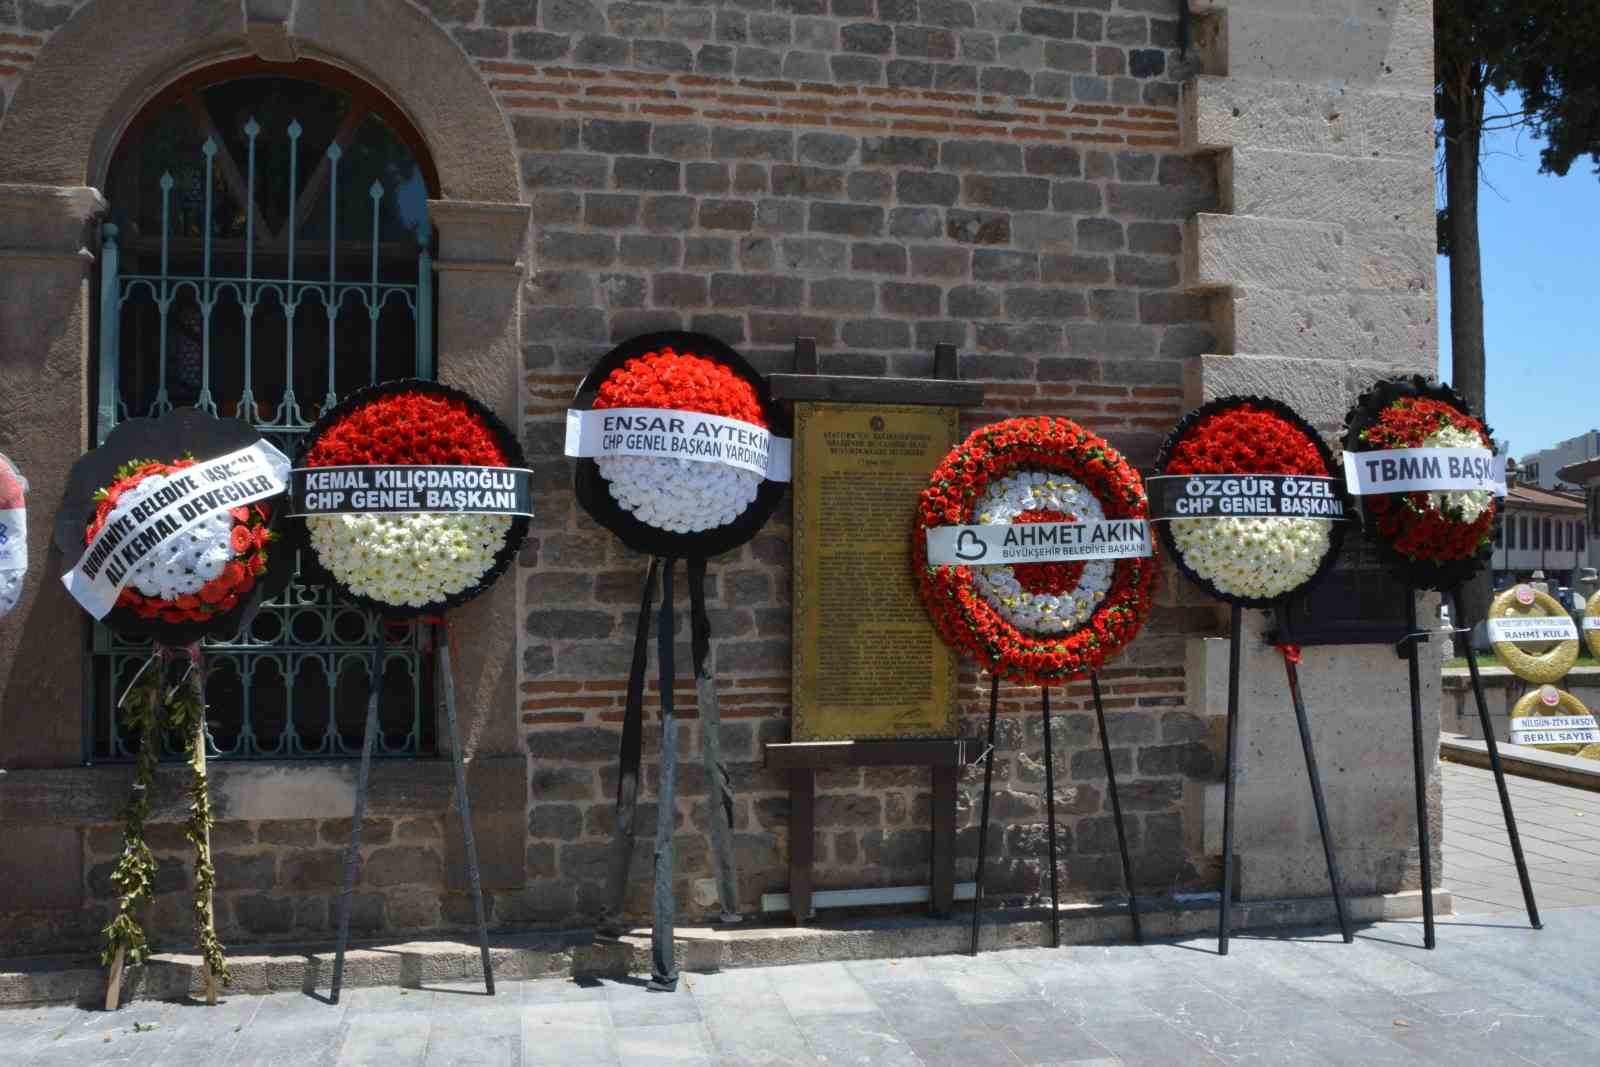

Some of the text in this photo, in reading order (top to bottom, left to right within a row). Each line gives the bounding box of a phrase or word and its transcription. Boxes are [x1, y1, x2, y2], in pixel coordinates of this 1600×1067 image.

[603, 416, 684, 434] ENSAR
[602, 434, 623, 451] CHP
[626, 434, 667, 452] GENEL
[671, 437, 722, 458] BAŞKAN
[305, 468, 515, 492] KEMAL KILIÇDAROĞLU
[1366, 458, 1441, 483] TBMM
[1185, 478, 1334, 498] ÖZGÜR ÖZEL
[305, 491, 517, 512] CHP GENEL BAŞKANI
[1176, 497, 1343, 518] CHP GENEL BAŞKANI
[82, 514, 135, 581] BURHANİYE
[130, 475, 200, 524] BELEDİYE
[105, 474, 274, 588] ALİ KEMAL DEVECİLER
[1003, 522, 1145, 547] AHMET AKIN
[1002, 545, 1061, 559] BÜYÜKŞEHİR
[1063, 544, 1105, 556] BELEDİYE
[1543, 629, 1570, 638] KULA
